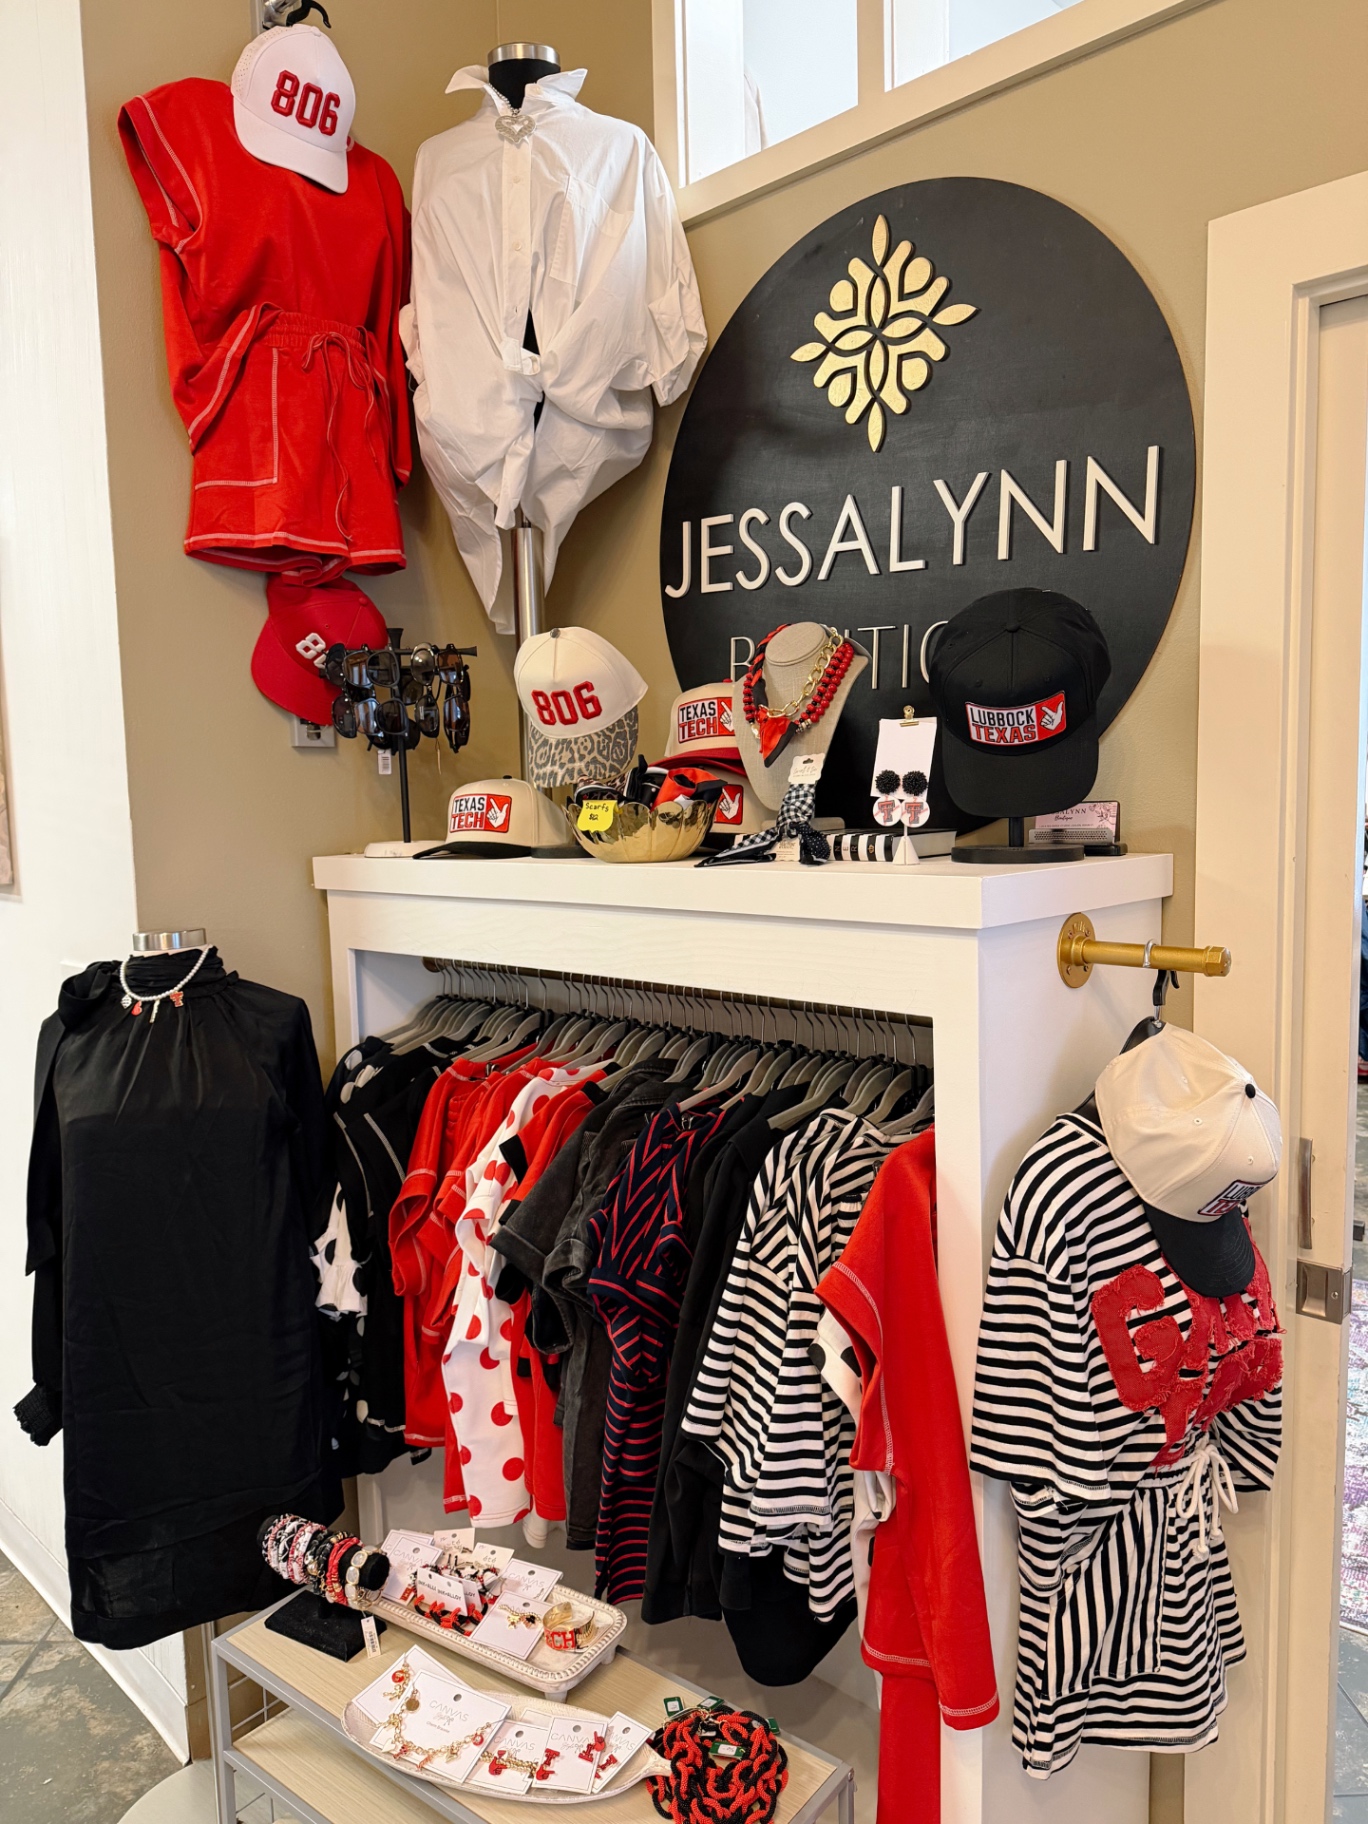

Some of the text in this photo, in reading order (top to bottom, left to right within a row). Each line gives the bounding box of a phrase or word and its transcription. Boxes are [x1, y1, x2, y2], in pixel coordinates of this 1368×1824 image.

[271, 69, 341, 136] 806
[664, 445, 1160, 599] JESSALYNN
[531, 681, 602, 726] 806
[679, 701, 717, 721] TEXAS
[970, 707, 1036, 727] LUBBOCK
[678, 717, 718, 740] TECH
[972, 723, 1037, 744] TEXAS
[453, 796, 486, 812] TEXAS
[585, 802, 609, 813] Scarfs
[451, 811, 485, 829] TECH
[429, 1700, 469, 1722] CANVAS
